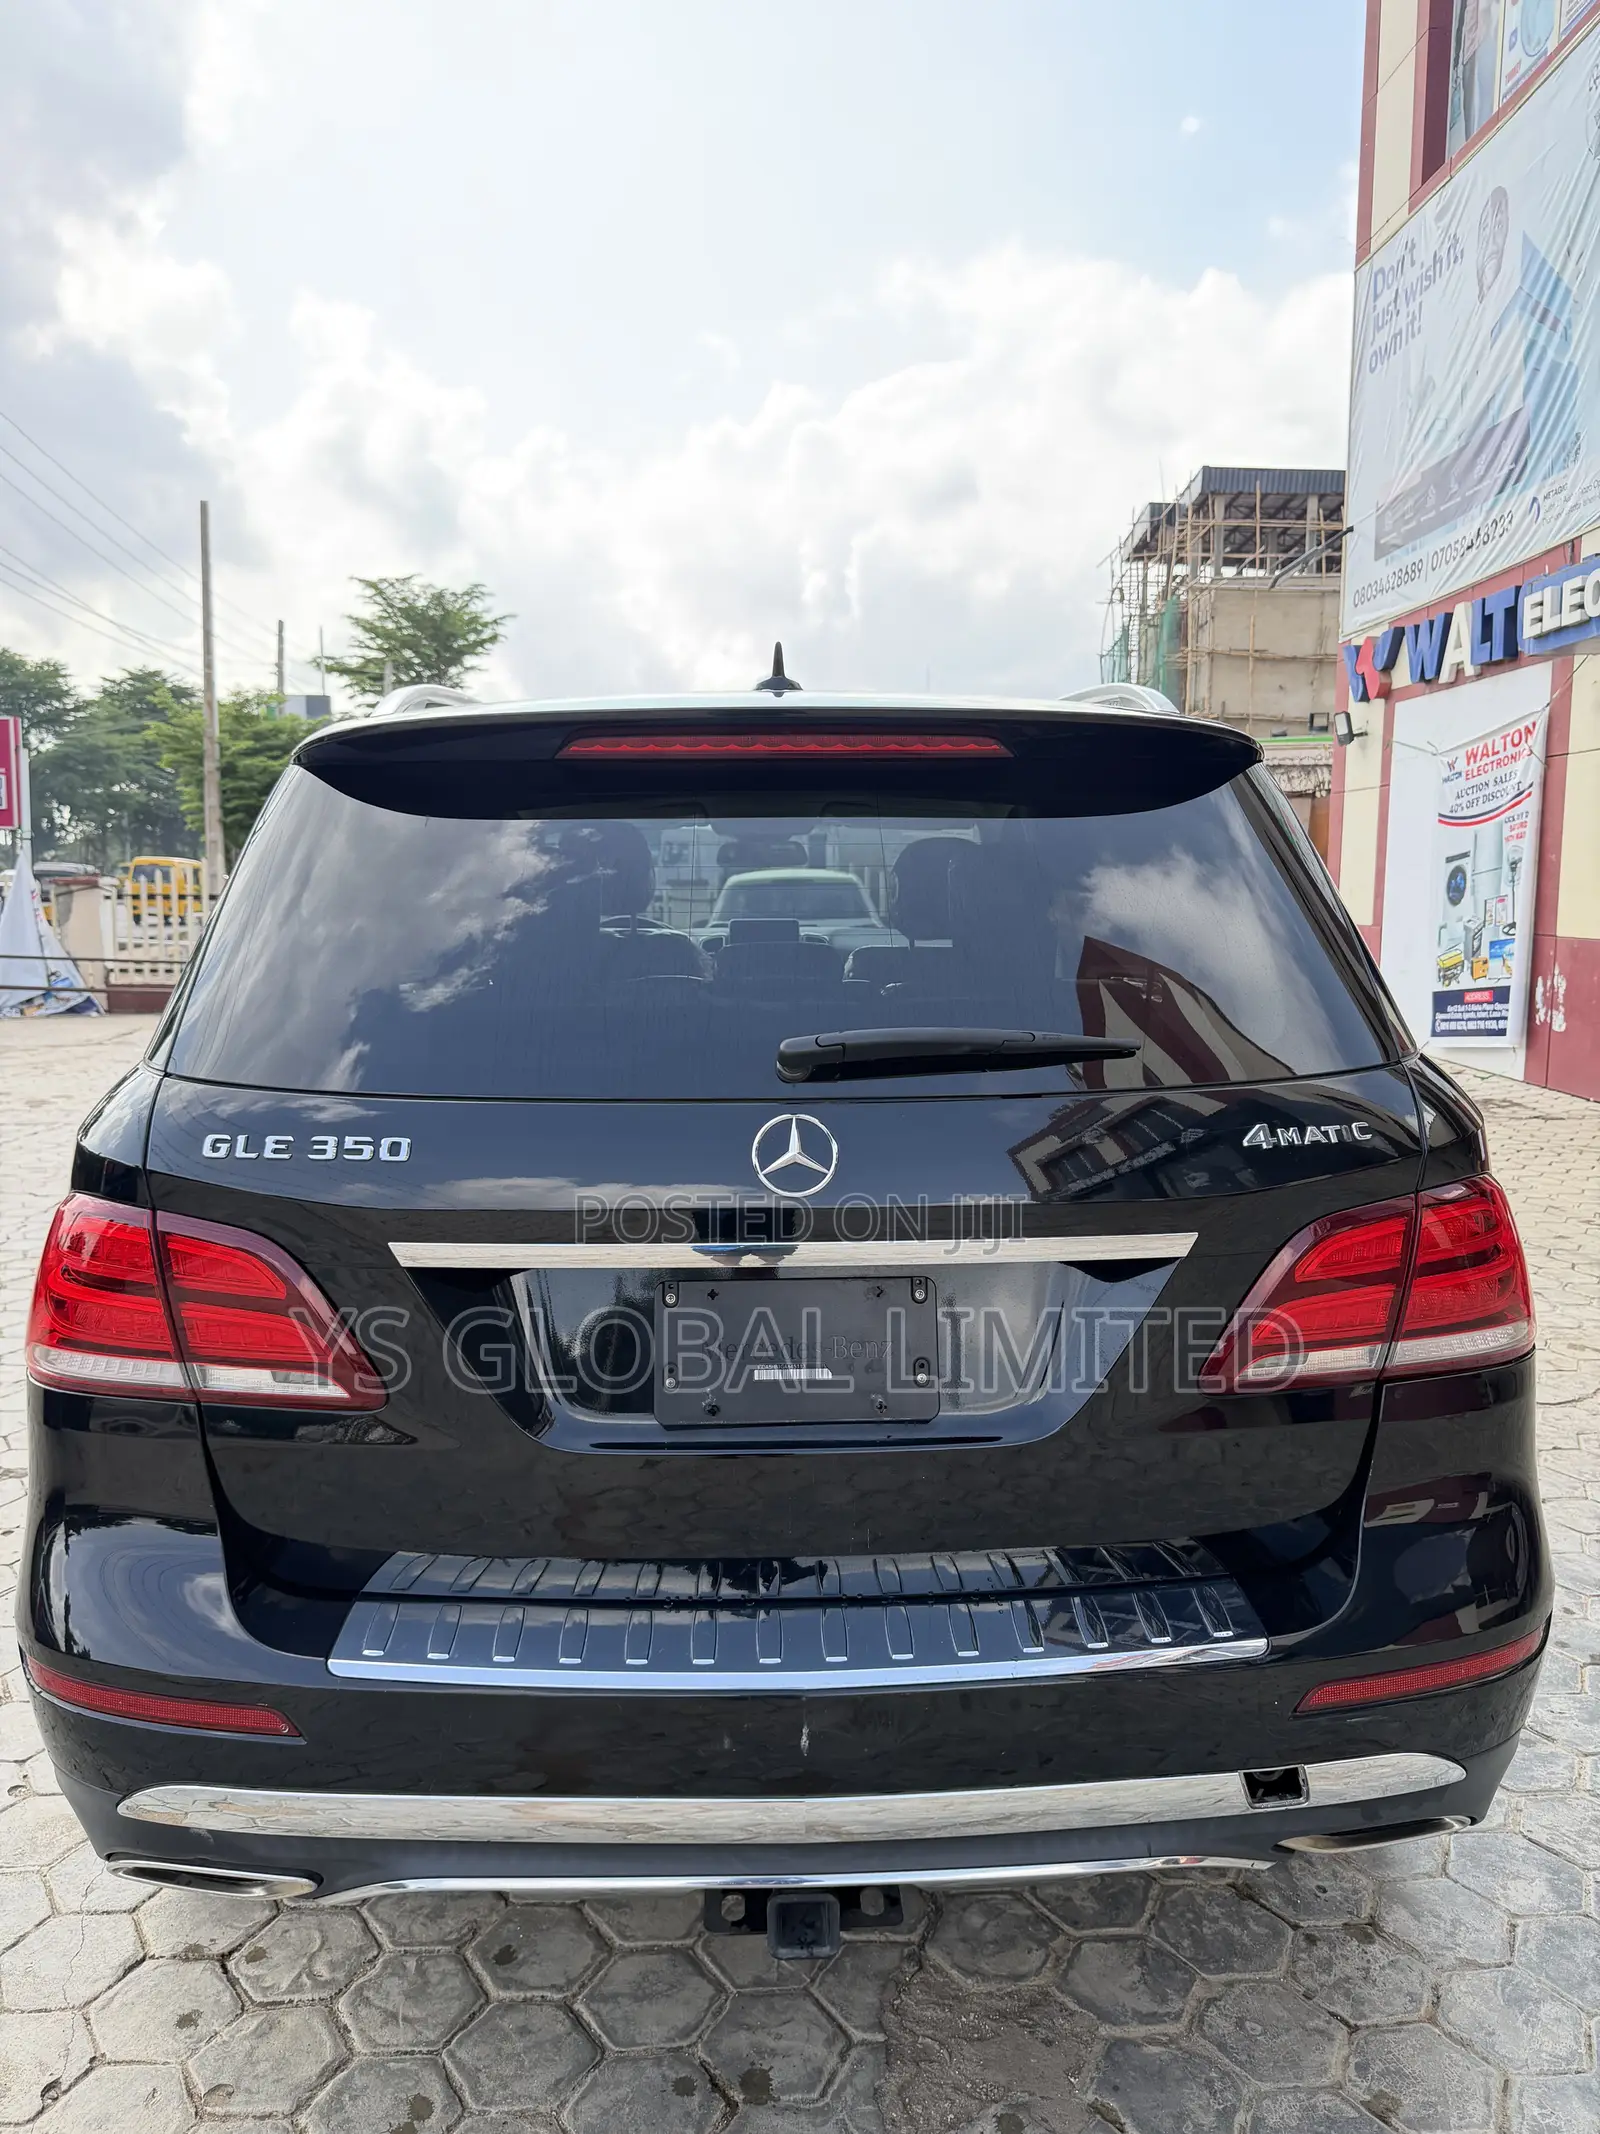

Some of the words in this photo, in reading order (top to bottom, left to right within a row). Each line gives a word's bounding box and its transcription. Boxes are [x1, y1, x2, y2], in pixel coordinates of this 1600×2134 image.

[1465, 720, 1537, 766] WALTON
[1465, 745, 1533, 782] ELECTRONICS
[1455, 779, 1489, 801] AUCTION
[1493, 769, 1518, 787] SALES
[1465, 797, 1481, 810] OFF
[1482, 780, 1523, 804] DISCOUNT
[202, 1134, 295, 1160] GLE
[307, 1135, 412, 1162] 350
[1242, 1121, 1373, 1150] 4MATIC
